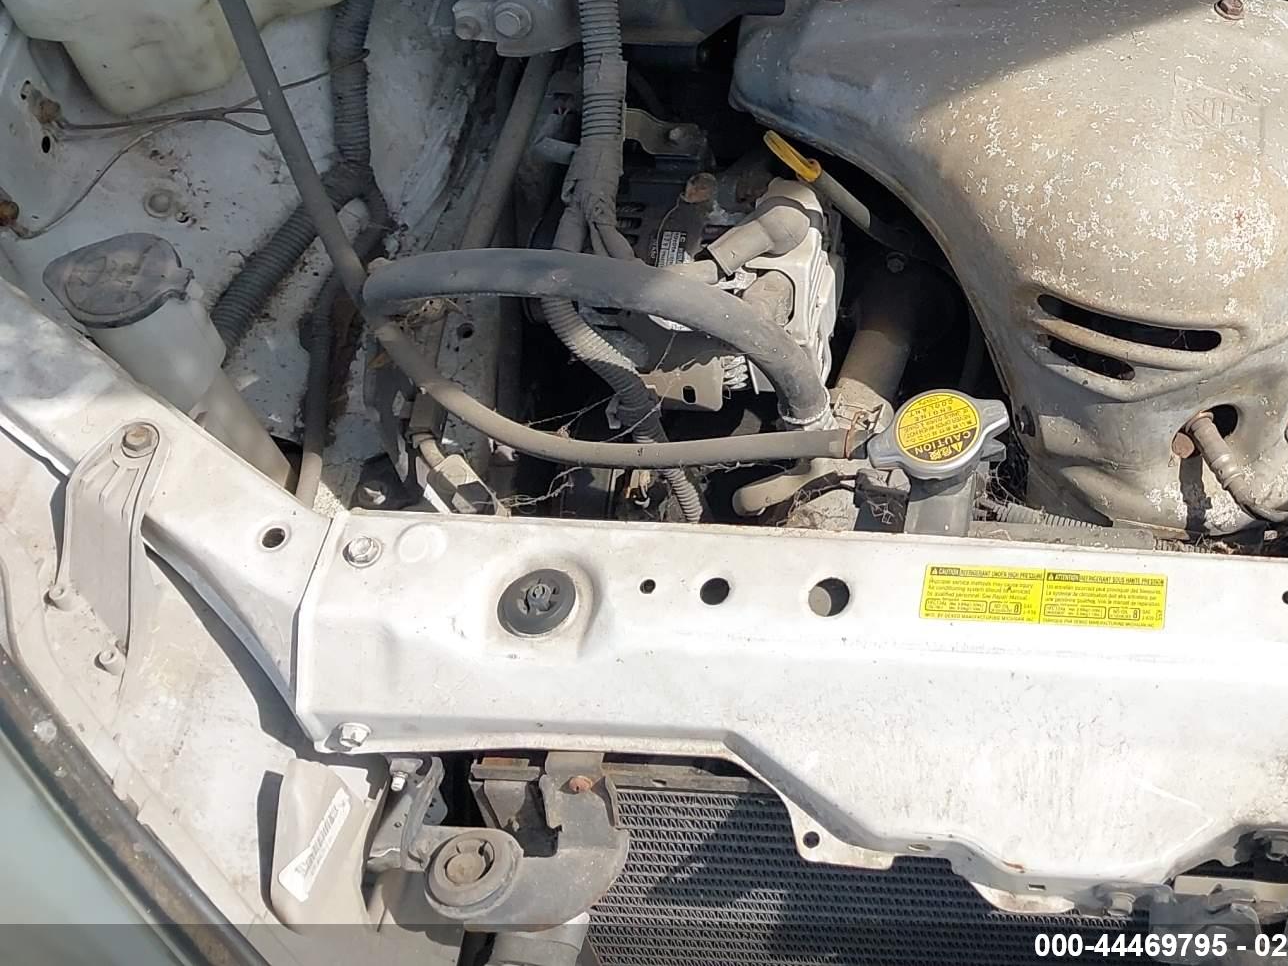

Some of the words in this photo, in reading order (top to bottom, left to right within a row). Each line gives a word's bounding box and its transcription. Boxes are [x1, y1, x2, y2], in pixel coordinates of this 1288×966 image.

[910, 399, 953, 417] COOLANT
[915, 406, 952, 421] ENGINE
[915, 430, 971, 455] CAUTION
[938, 567, 959, 577] CAUTION
